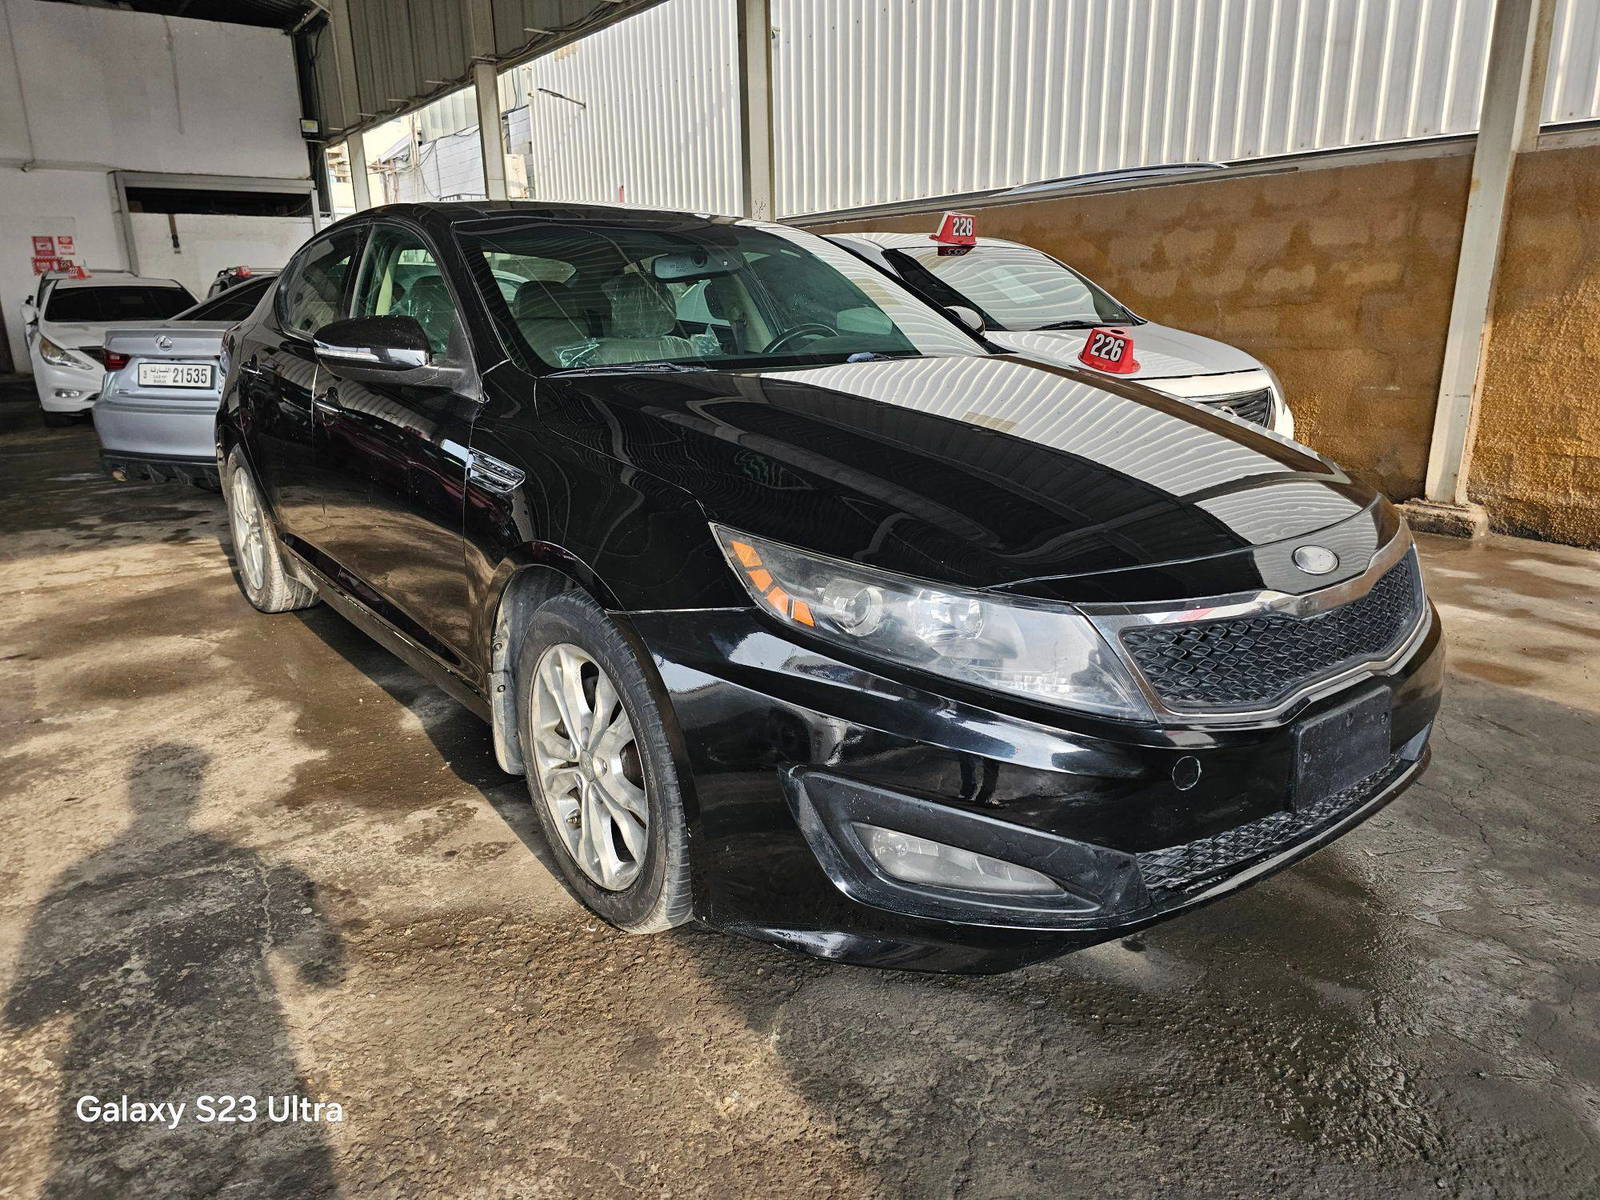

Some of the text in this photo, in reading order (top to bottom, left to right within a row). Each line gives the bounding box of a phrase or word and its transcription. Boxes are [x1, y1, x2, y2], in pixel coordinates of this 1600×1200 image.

[952, 217, 973, 237] 228
[1090, 333, 1125, 362] 226
[172, 367, 208, 384] 21535
